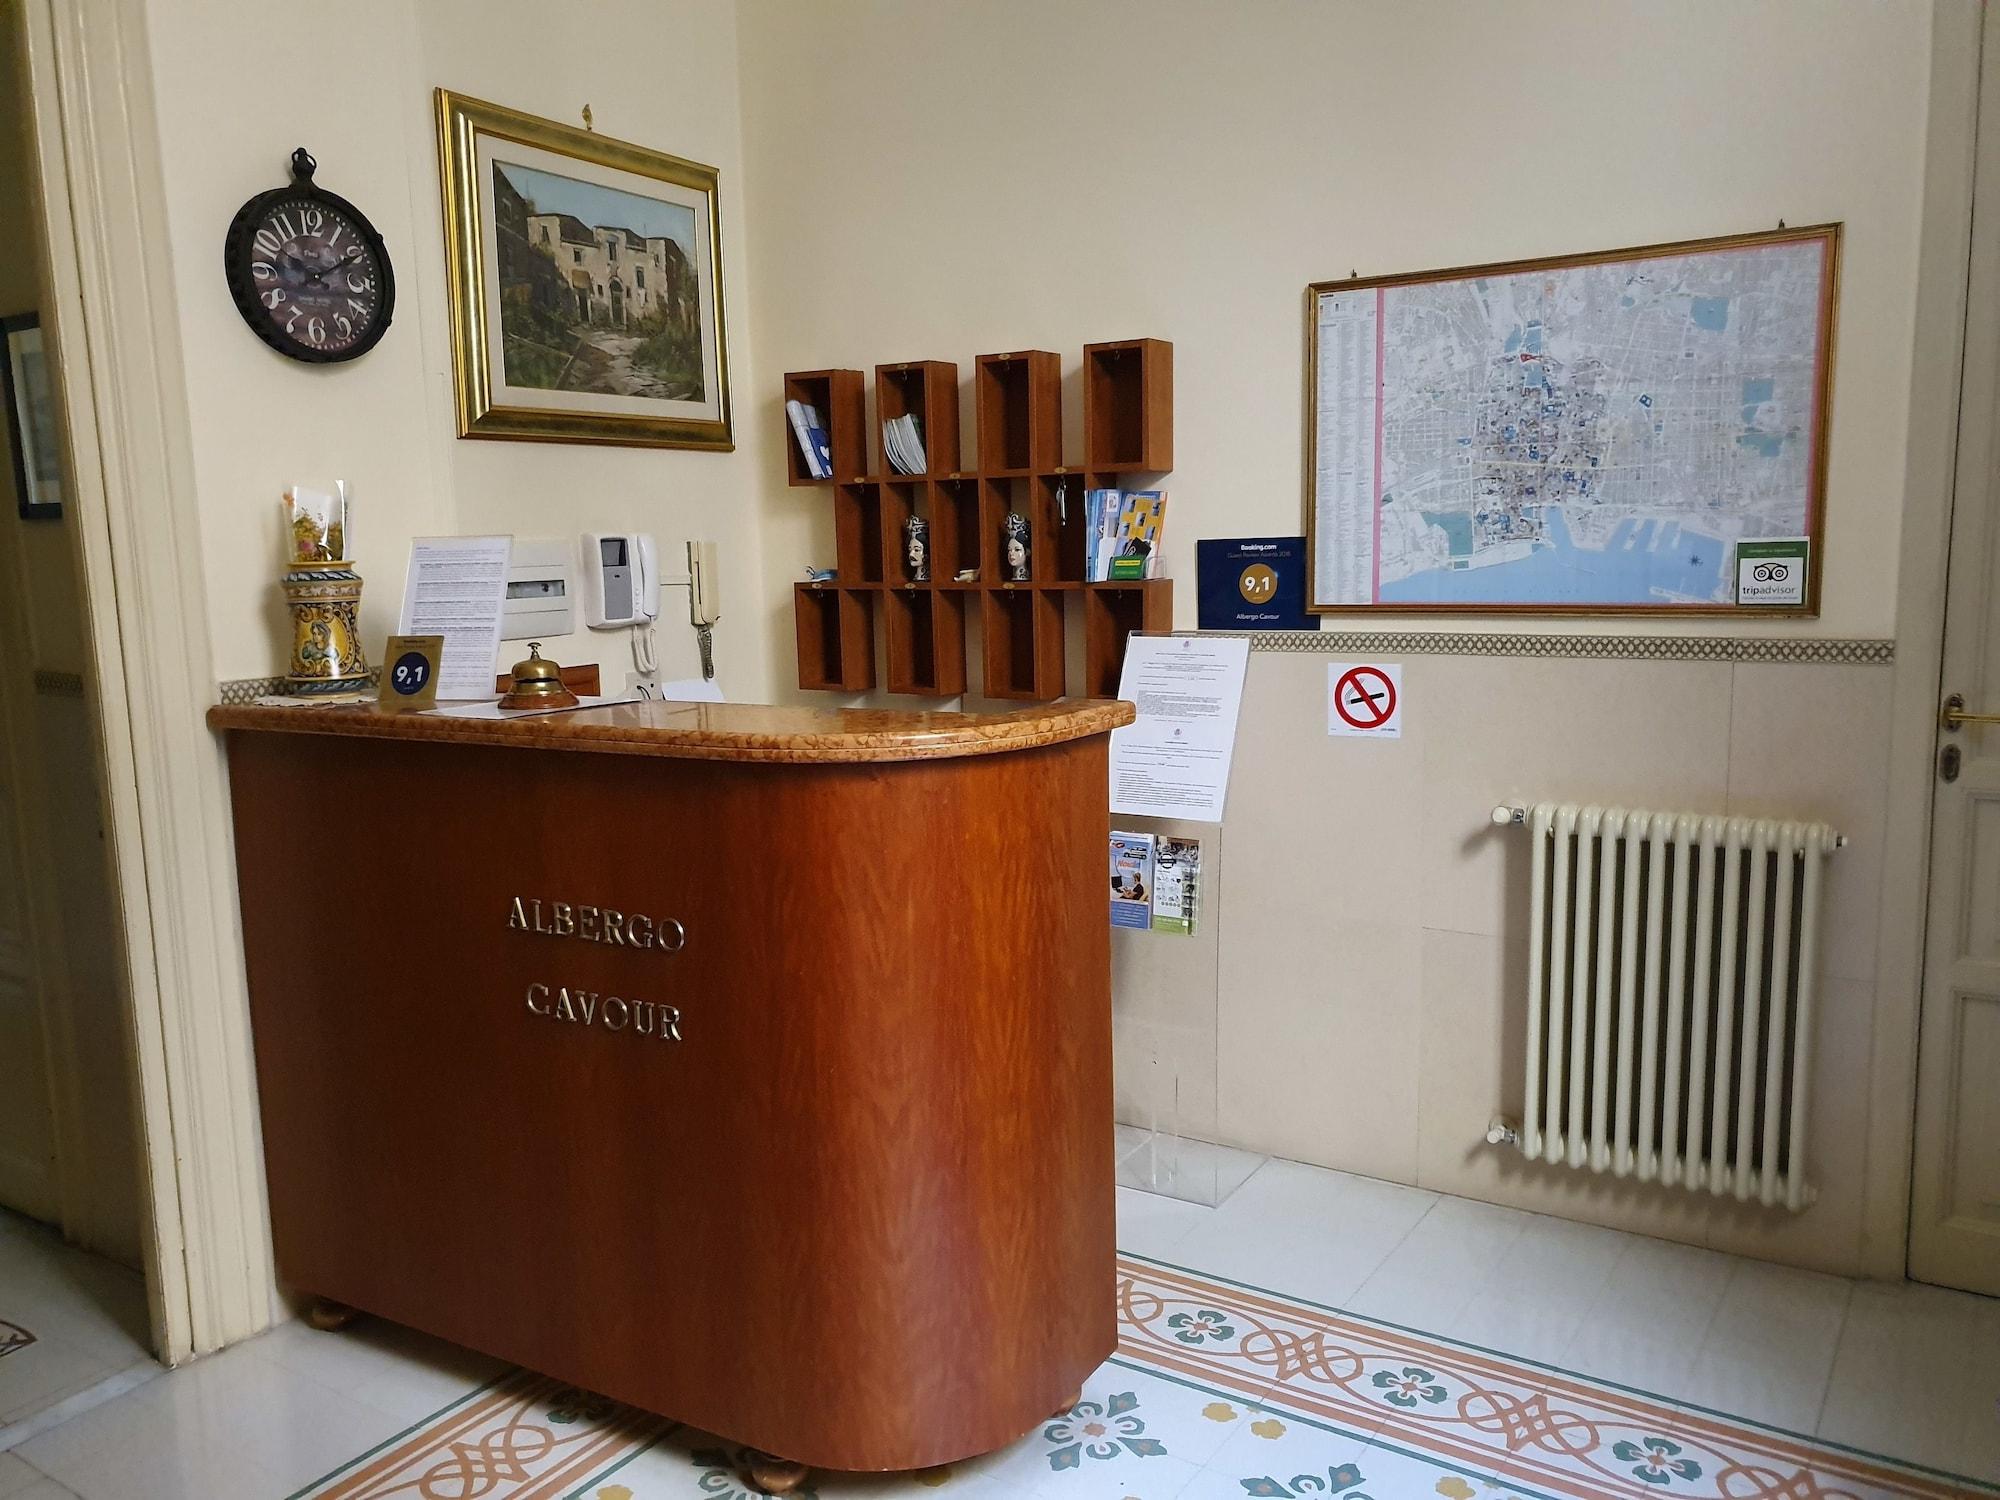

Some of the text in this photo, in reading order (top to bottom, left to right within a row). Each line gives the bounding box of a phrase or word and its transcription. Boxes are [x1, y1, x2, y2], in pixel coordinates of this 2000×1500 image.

[269, 213, 298, 242] 11
[300, 209, 325, 238] 12
[253, 228, 282, 262] 10
[328, 224, 343, 247] 1
[346, 245, 363, 265] 2
[252, 261, 279, 282] 9
[346, 272, 371, 294] 3
[261, 287, 287, 310] 8
[347, 298, 369, 322] 4
[286, 306, 304, 334] 7
[308, 316, 326, 344] 6
[333, 312, 352, 340] 5
[1244, 576, 1270, 593] 9,1
[1742, 585, 1796, 596] tripadvisor
[1236, 613, 1259, 621] Albergo
[396, 665, 424, 685] 9,1
[507, 896, 685, 952] ALBERGO
[526, 982, 683, 1042] CAVOUR
